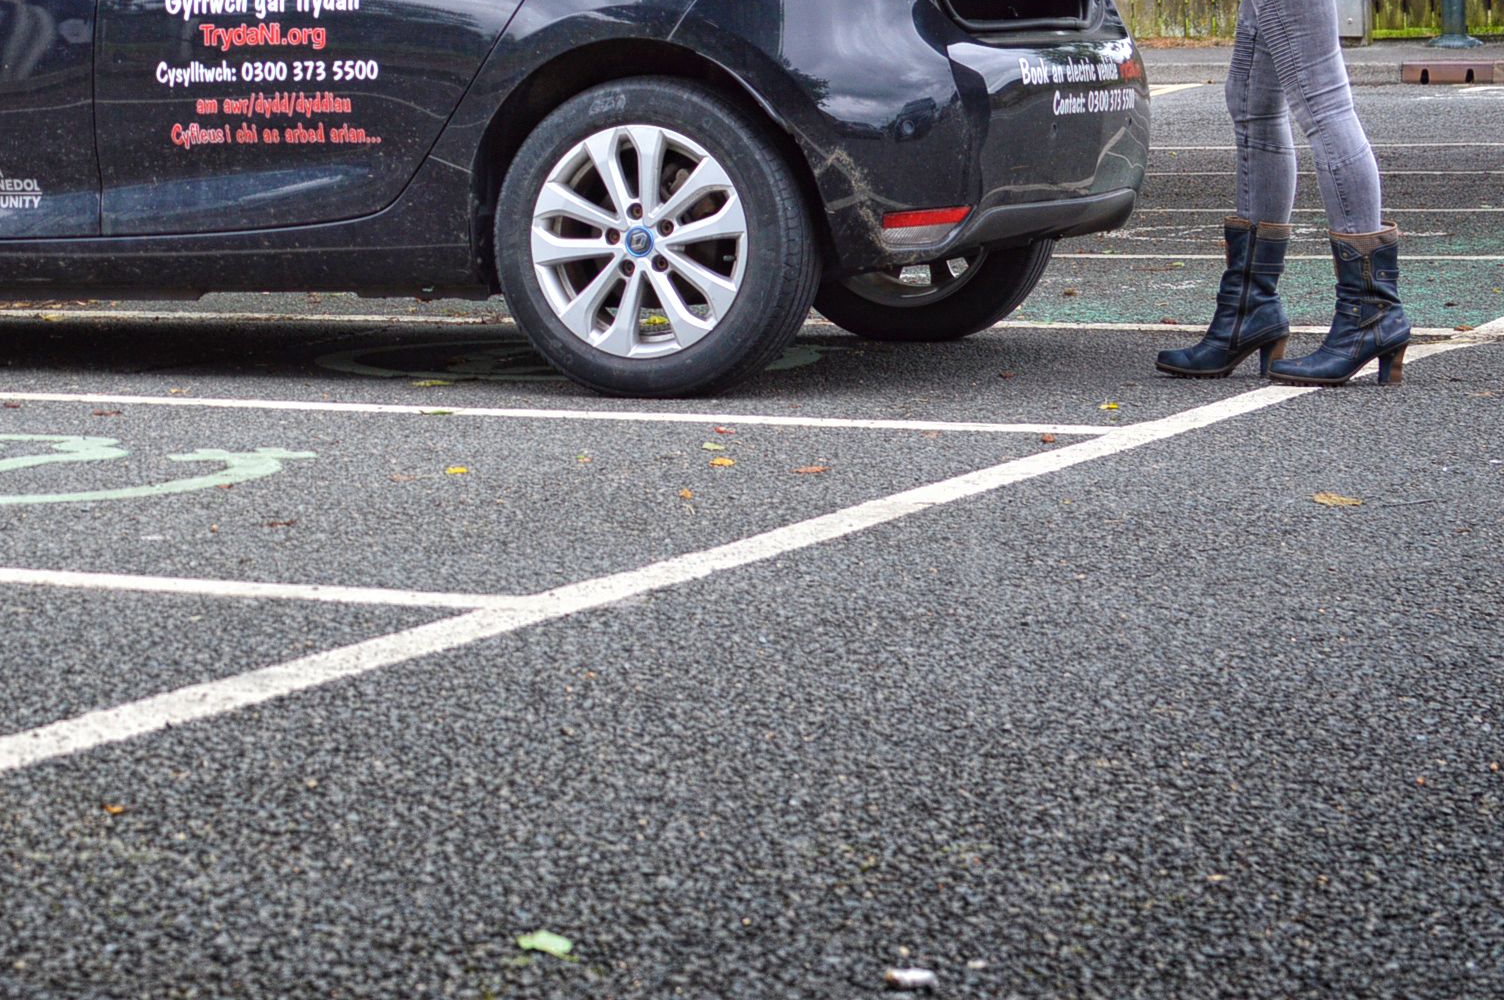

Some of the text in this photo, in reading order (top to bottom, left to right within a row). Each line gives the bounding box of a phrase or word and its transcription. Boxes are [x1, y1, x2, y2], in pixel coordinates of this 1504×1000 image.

[199, 22, 326, 51] TrydaNi.org
[156, 60, 379, 87] Cysylltwch: 0300 373 5500
[1018, 57, 1049, 85] Book
[1052, 63, 1064, 84] an
[1066, 56, 1096, 82] electric
[196, 91, 352, 119] am awr/dydd/dyddiau
[1053, 88, 1135, 115] Contact: 0300 373 5500
[171, 122, 223, 150] Cyfleus
[224, 124, 232, 143] i
[236, 122, 258, 144] chi
[262, 128, 280, 144] ac
[284, 121, 325, 144] arbed
